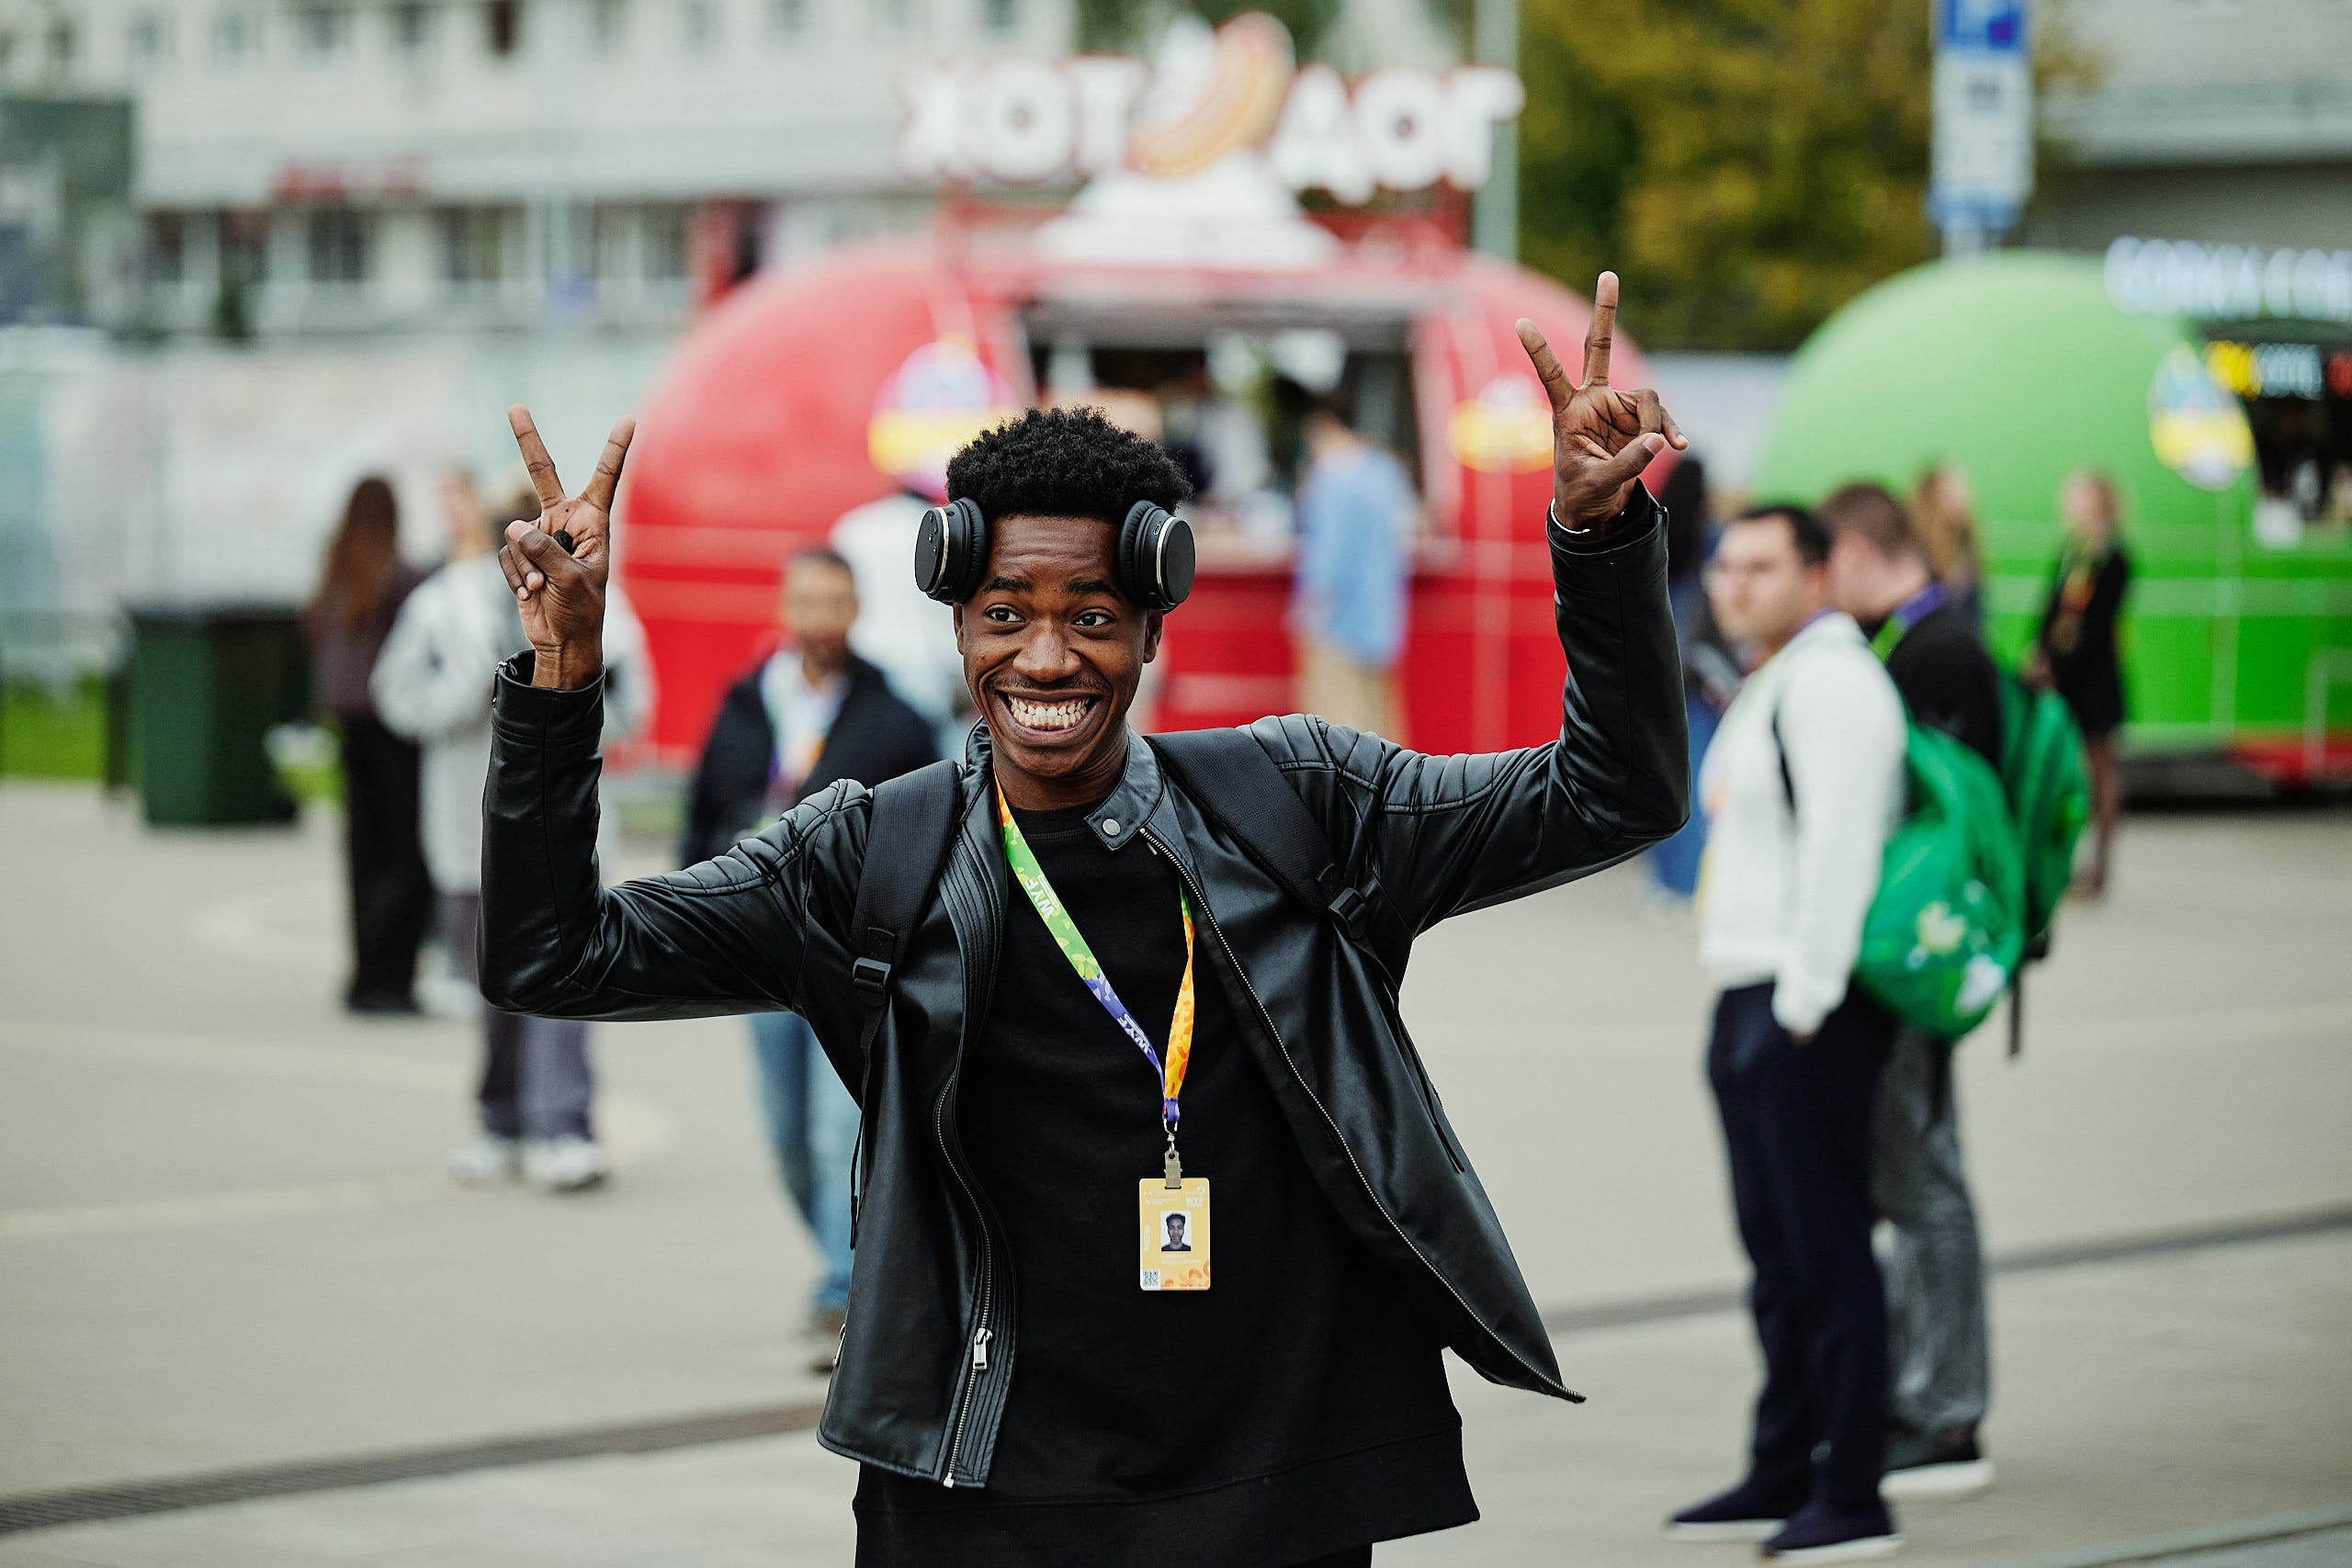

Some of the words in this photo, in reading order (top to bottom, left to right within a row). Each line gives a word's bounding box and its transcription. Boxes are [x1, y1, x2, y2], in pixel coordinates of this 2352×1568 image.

[896, 55, 1144, 183] ХОТ
[1266, 62, 1525, 204] ДОГ
[1023, 879, 1055, 919] WYF
[1116, 1016, 1148, 1054] WYF
